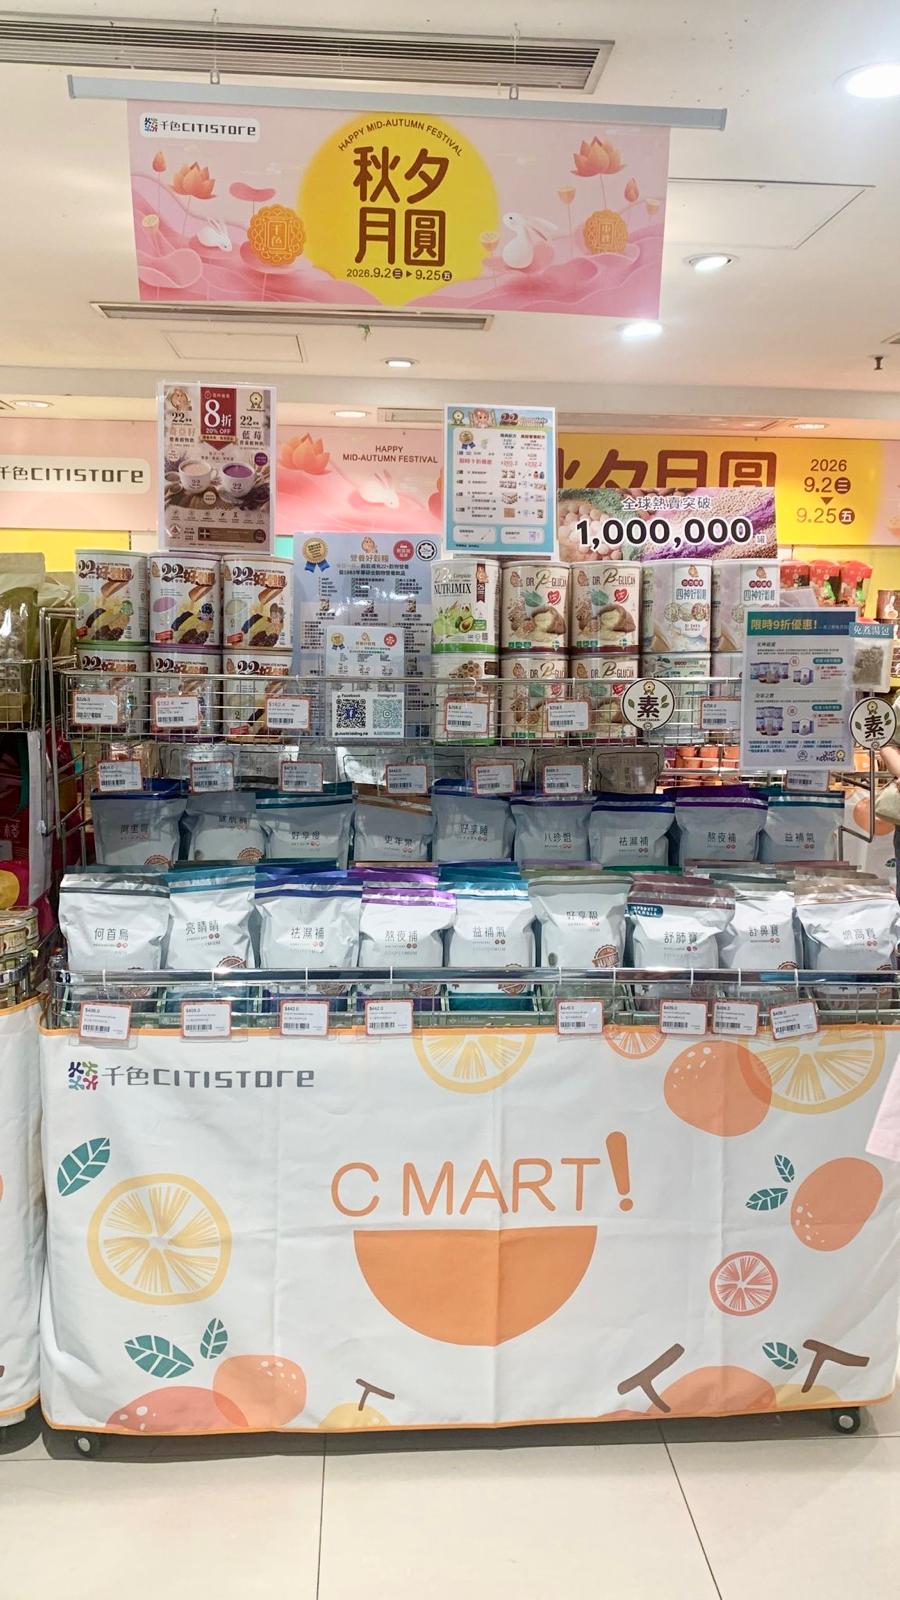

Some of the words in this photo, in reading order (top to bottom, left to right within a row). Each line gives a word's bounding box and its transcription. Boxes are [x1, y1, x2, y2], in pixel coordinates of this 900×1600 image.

[338, 128, 365, 151] HAPPY
[366, 118, 425, 133] MID-AUTUMN
[426, 125, 463, 157] FESTIVAL
[353, 146, 449, 204] 秋夕
[355, 207, 446, 267] 月圓
[342, 453, 396, 462] MID-AUTUMN
[398, 455, 439, 463] FESTIVAL
[375, 445, 403, 453] HAPPY
[810, 458, 847, 472] 2026
[622, 497, 711, 510] 全球熱賣突破
[576, 518, 752, 551] 1,000,000
[434, 584, 472, 594] NUTRIMIX
[638, 695, 660, 719] 素
[864, 714, 884, 738] 素
[95, 927, 129, 941] 何首烏
[331, 1162, 379, 1217] C
